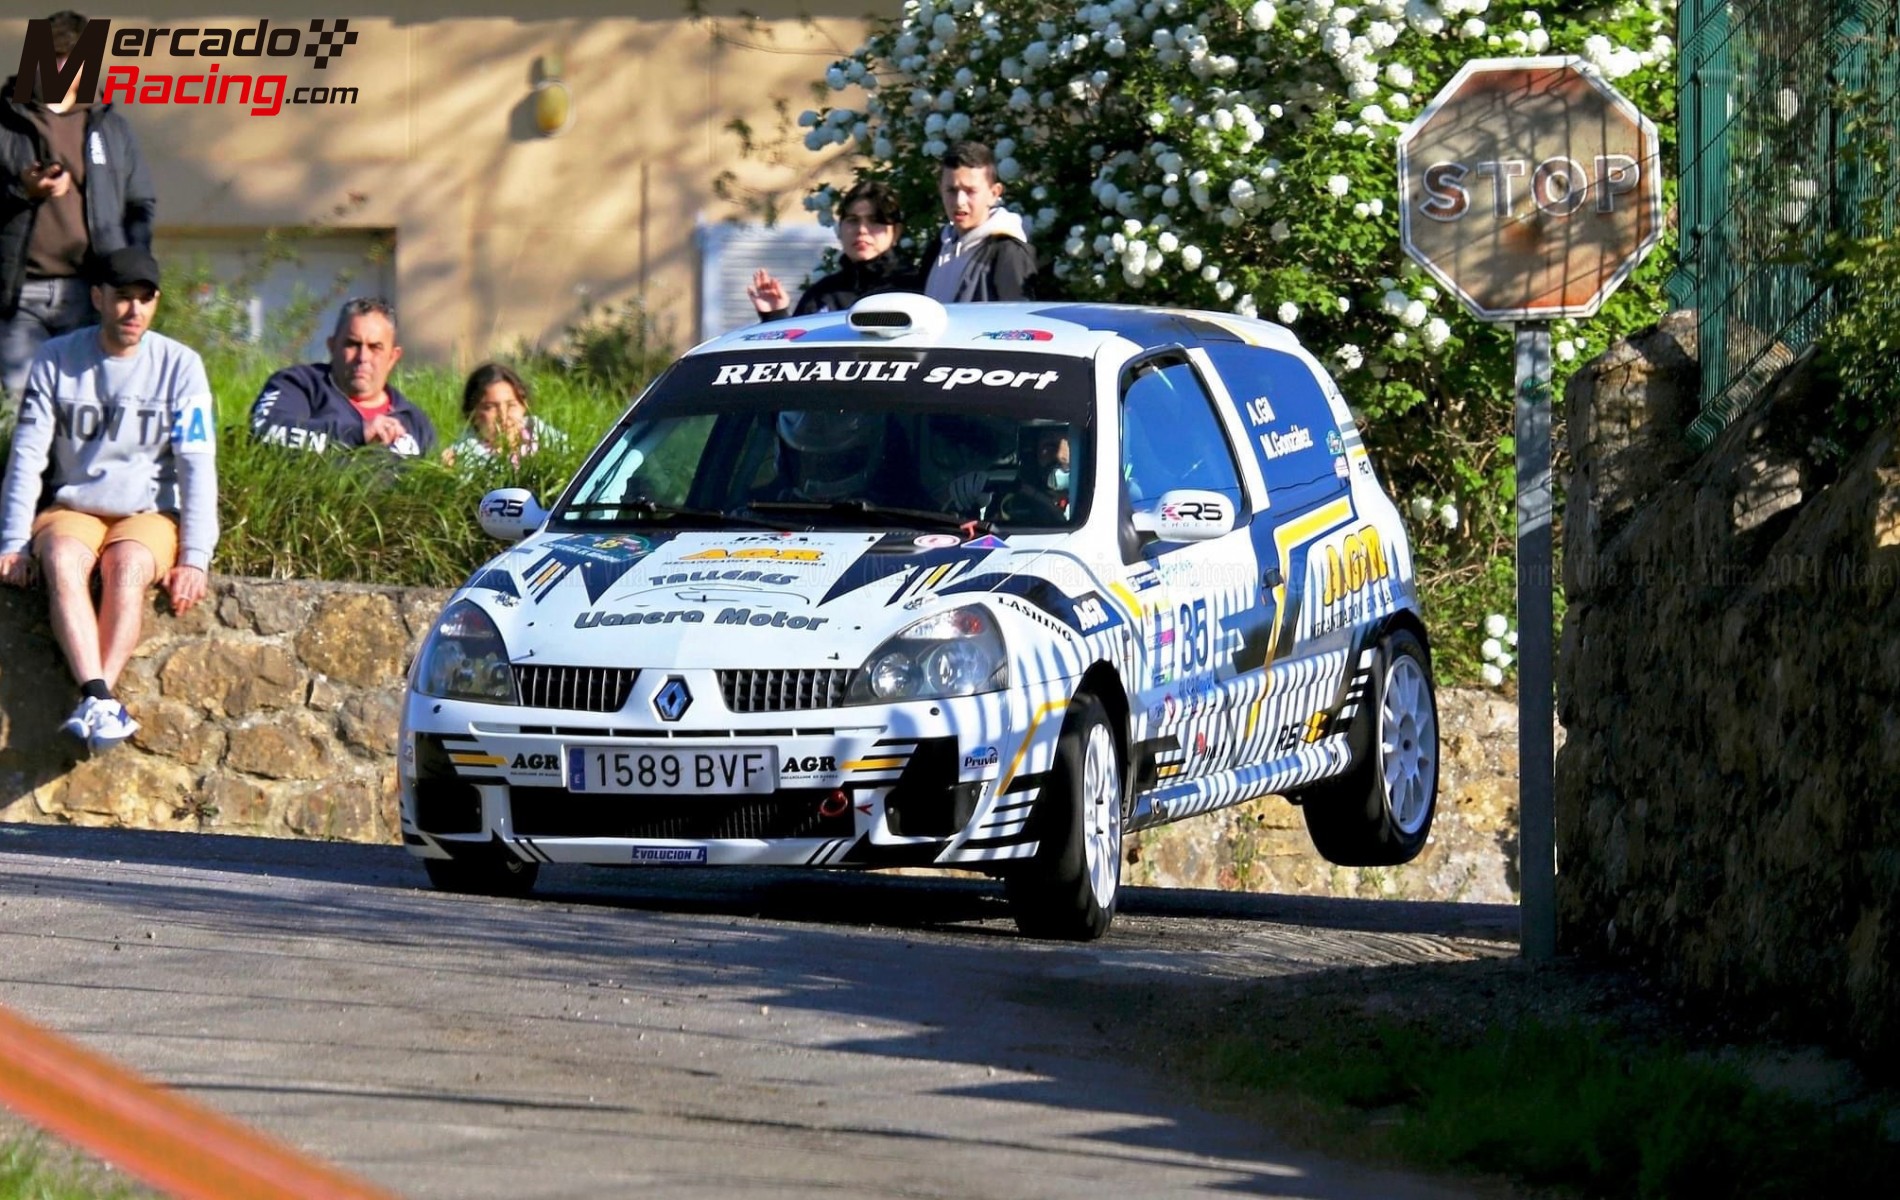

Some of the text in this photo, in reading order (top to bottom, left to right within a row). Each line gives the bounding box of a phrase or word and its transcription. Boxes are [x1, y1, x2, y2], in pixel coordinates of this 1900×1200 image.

[1419, 155, 1640, 222] STOP
[712, 361, 1059, 390] RENAULT sport
[573, 607, 829, 631] Llanera Motor
[1180, 597, 1209, 672] 35
[511, 753, 560, 770] AGR
[597, 754, 763, 787] 1589 BVF
[781, 756, 837, 773] AGR
